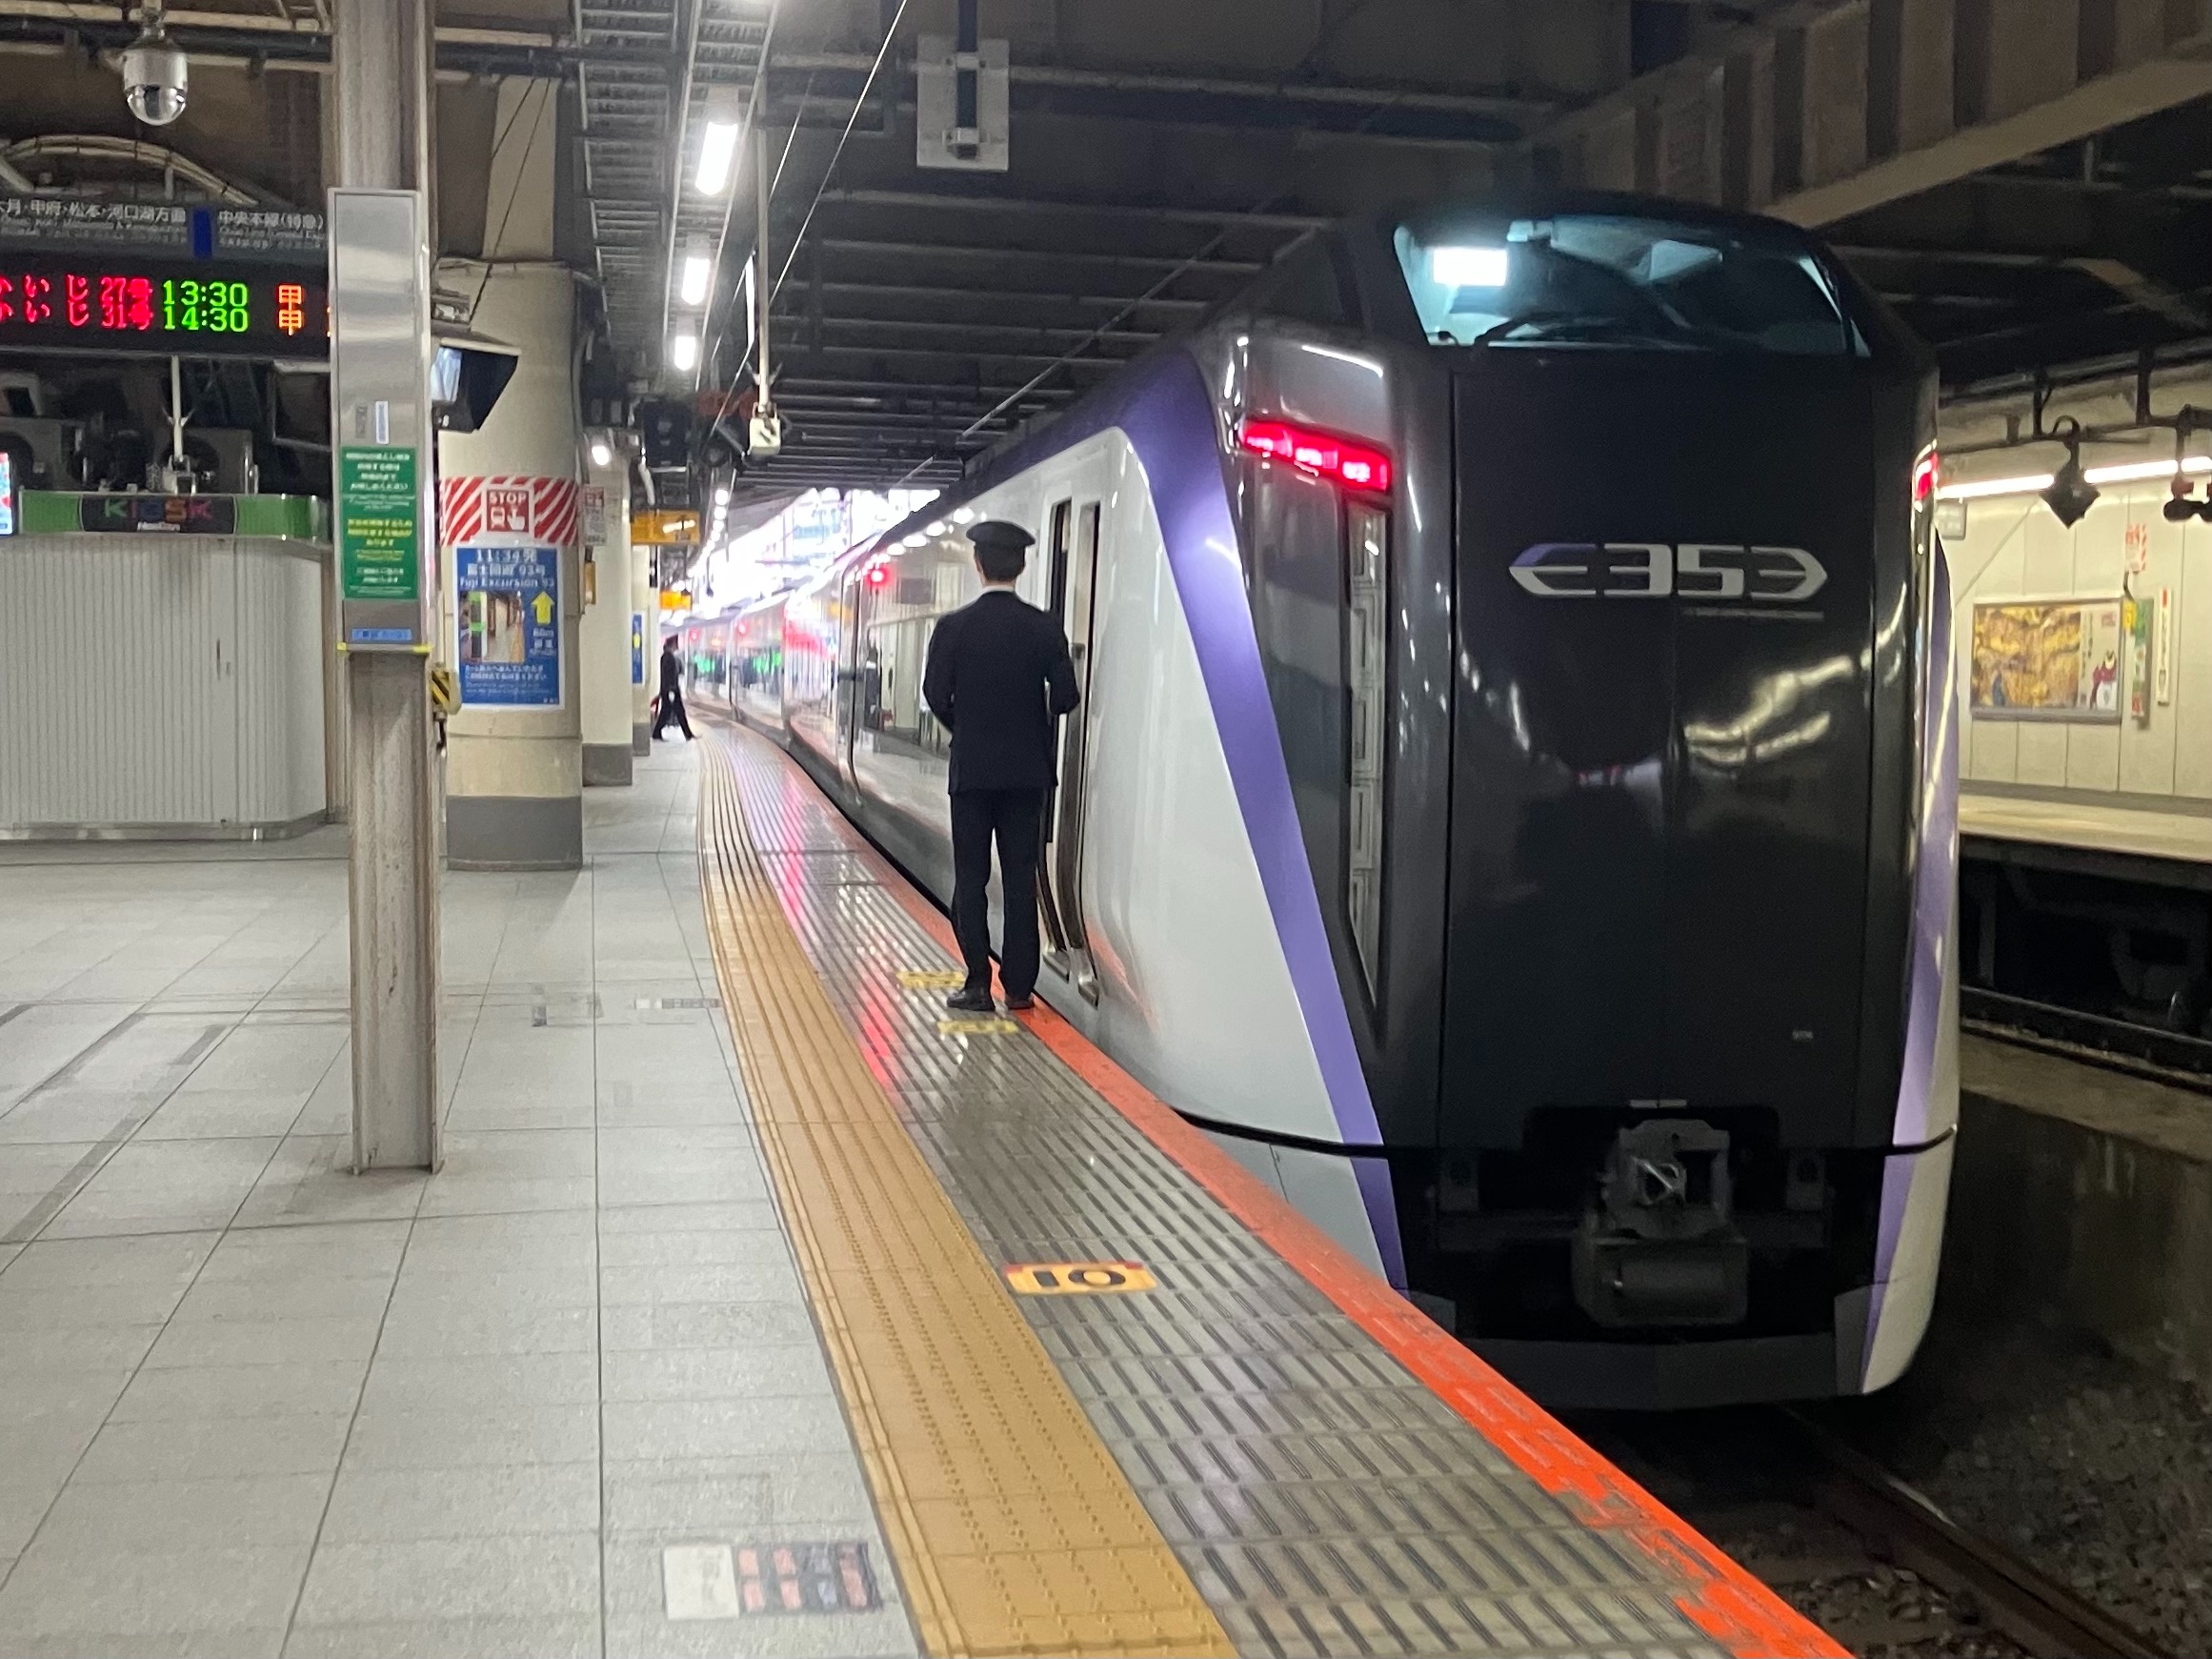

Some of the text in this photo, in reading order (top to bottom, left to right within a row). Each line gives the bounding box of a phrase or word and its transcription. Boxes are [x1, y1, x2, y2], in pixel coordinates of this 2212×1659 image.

[163, 279, 248, 307] 13:30
[163, 306, 249, 332] 14:30
[104, 497, 212, 521] KIOSK
[489, 492, 527, 504] STOP
[1509, 543, 1828, 602] E353
